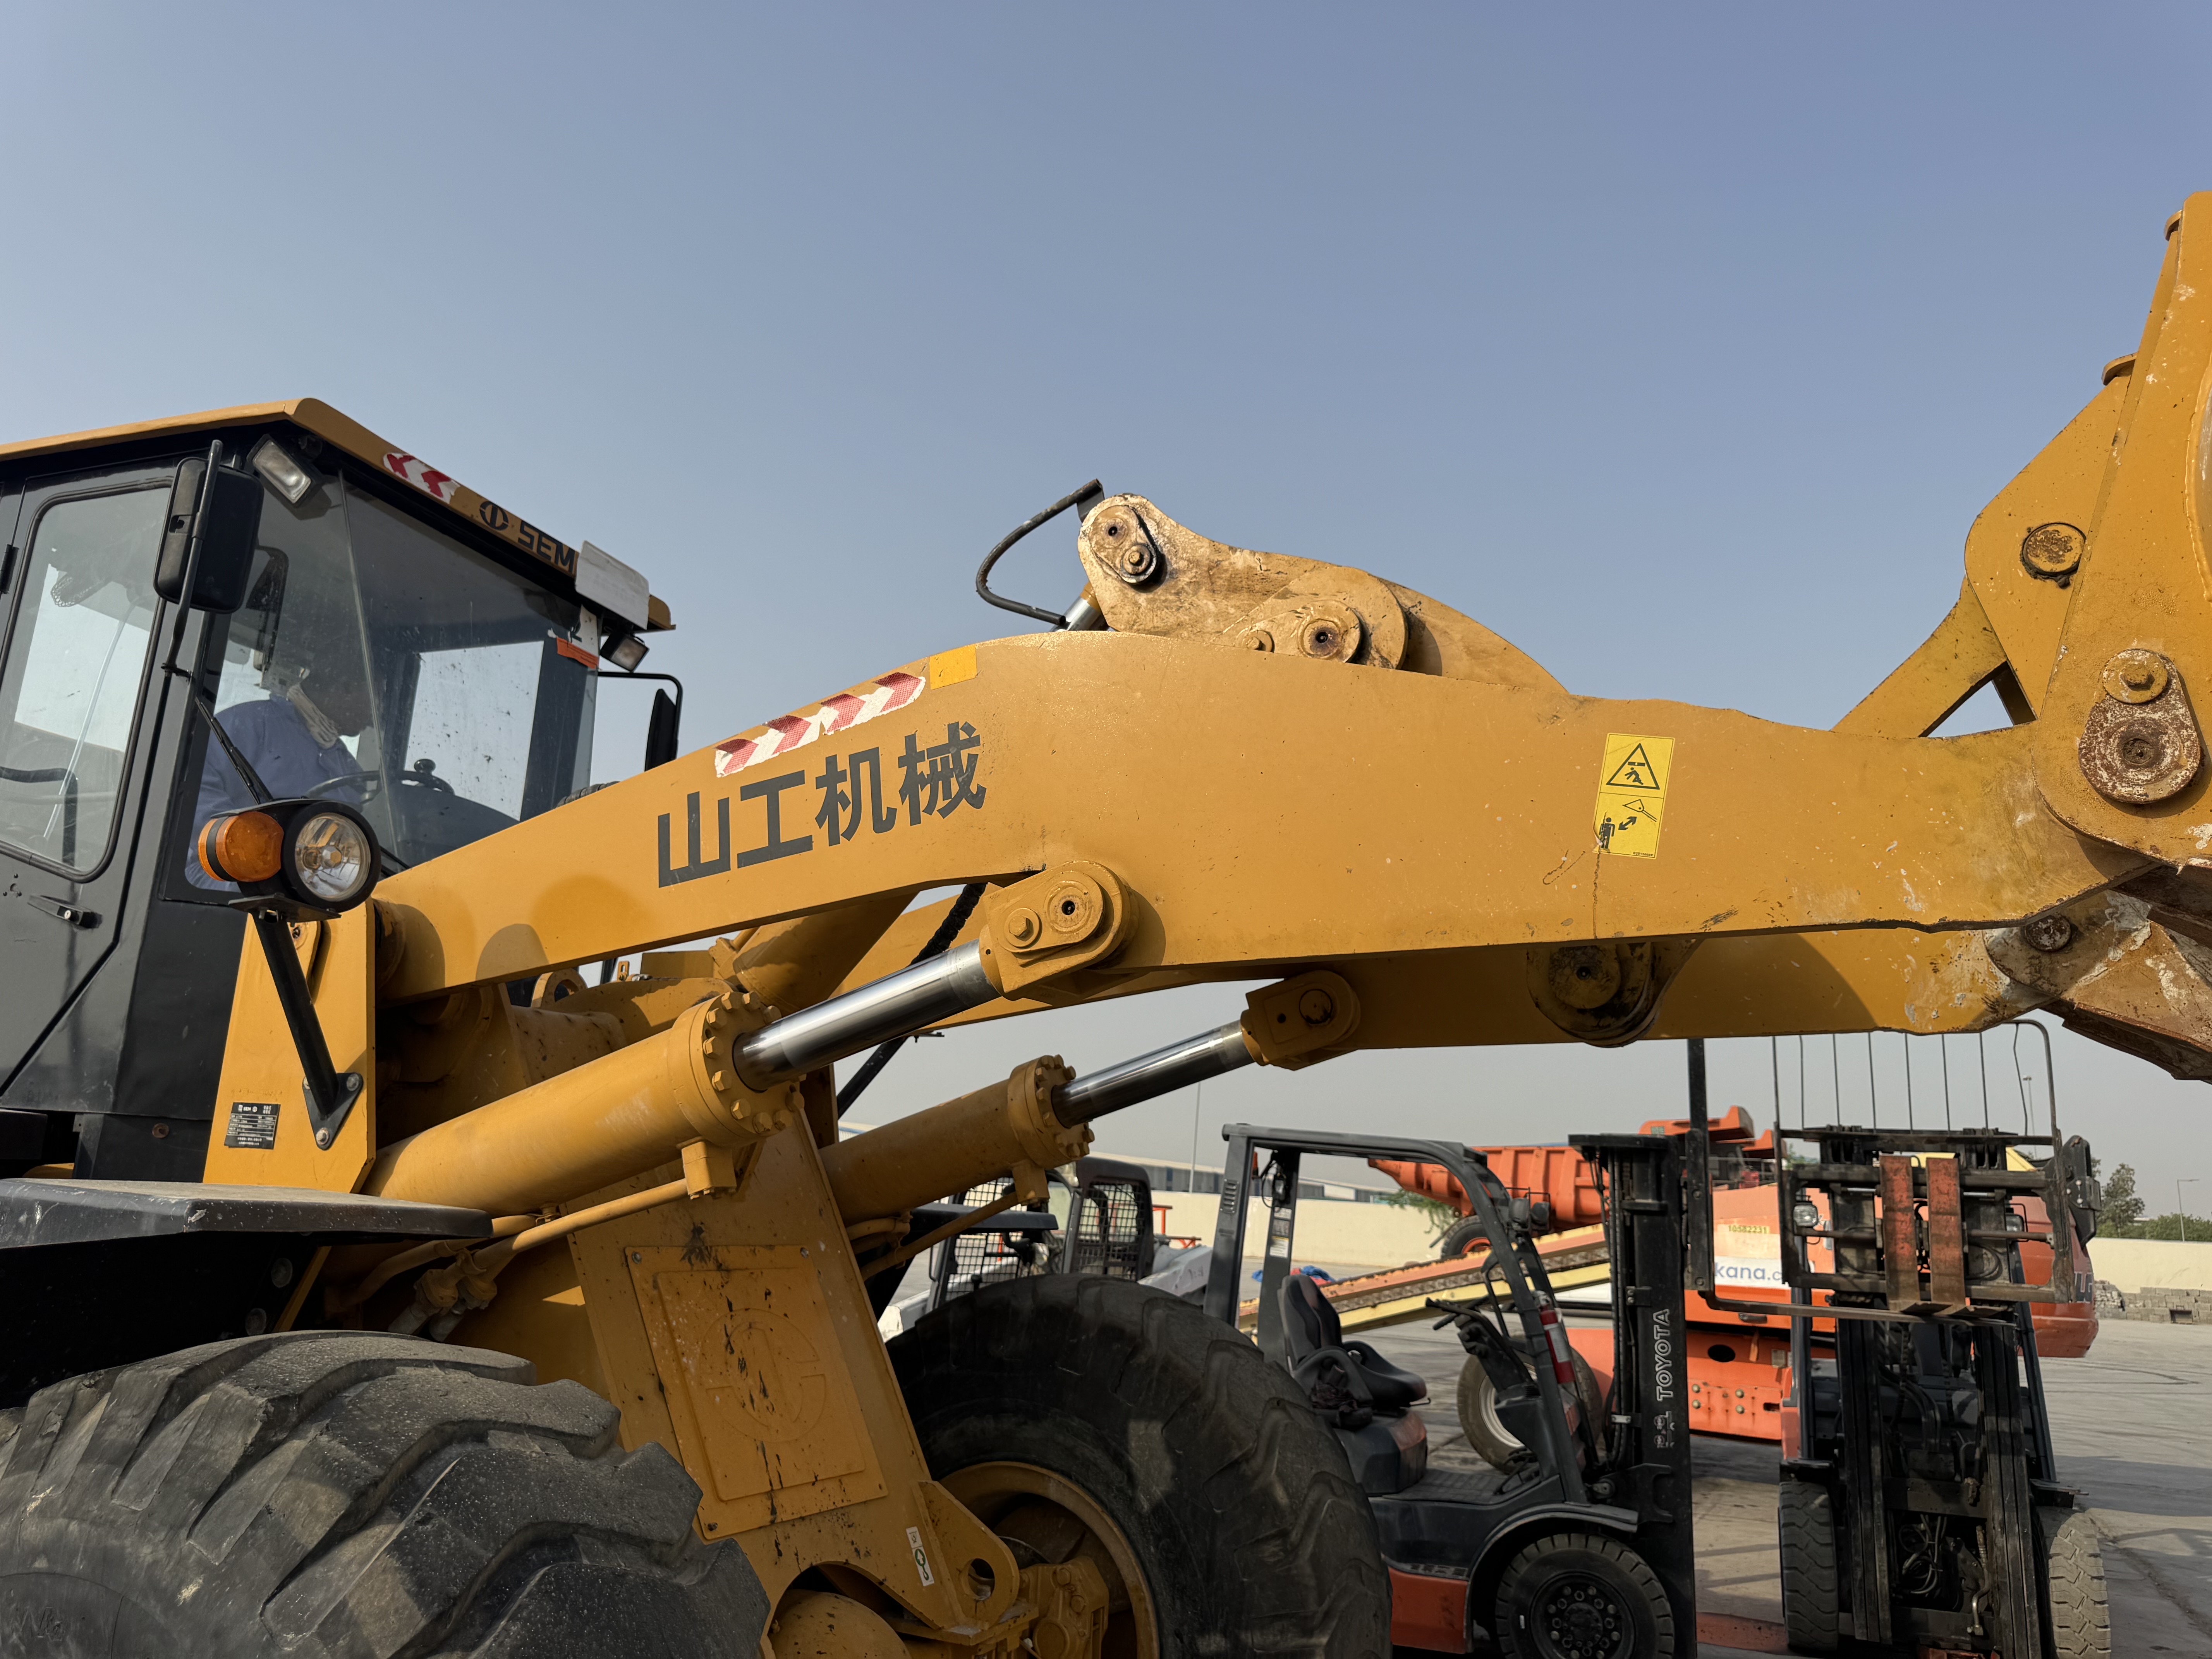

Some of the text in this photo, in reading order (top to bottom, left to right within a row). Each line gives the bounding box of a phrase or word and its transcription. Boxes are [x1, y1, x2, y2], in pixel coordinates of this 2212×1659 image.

[518, 520, 575, 573] SEM
[658, 721, 987, 888] 山工机械
[1653, 1309, 1673, 1402] TOYOTA
